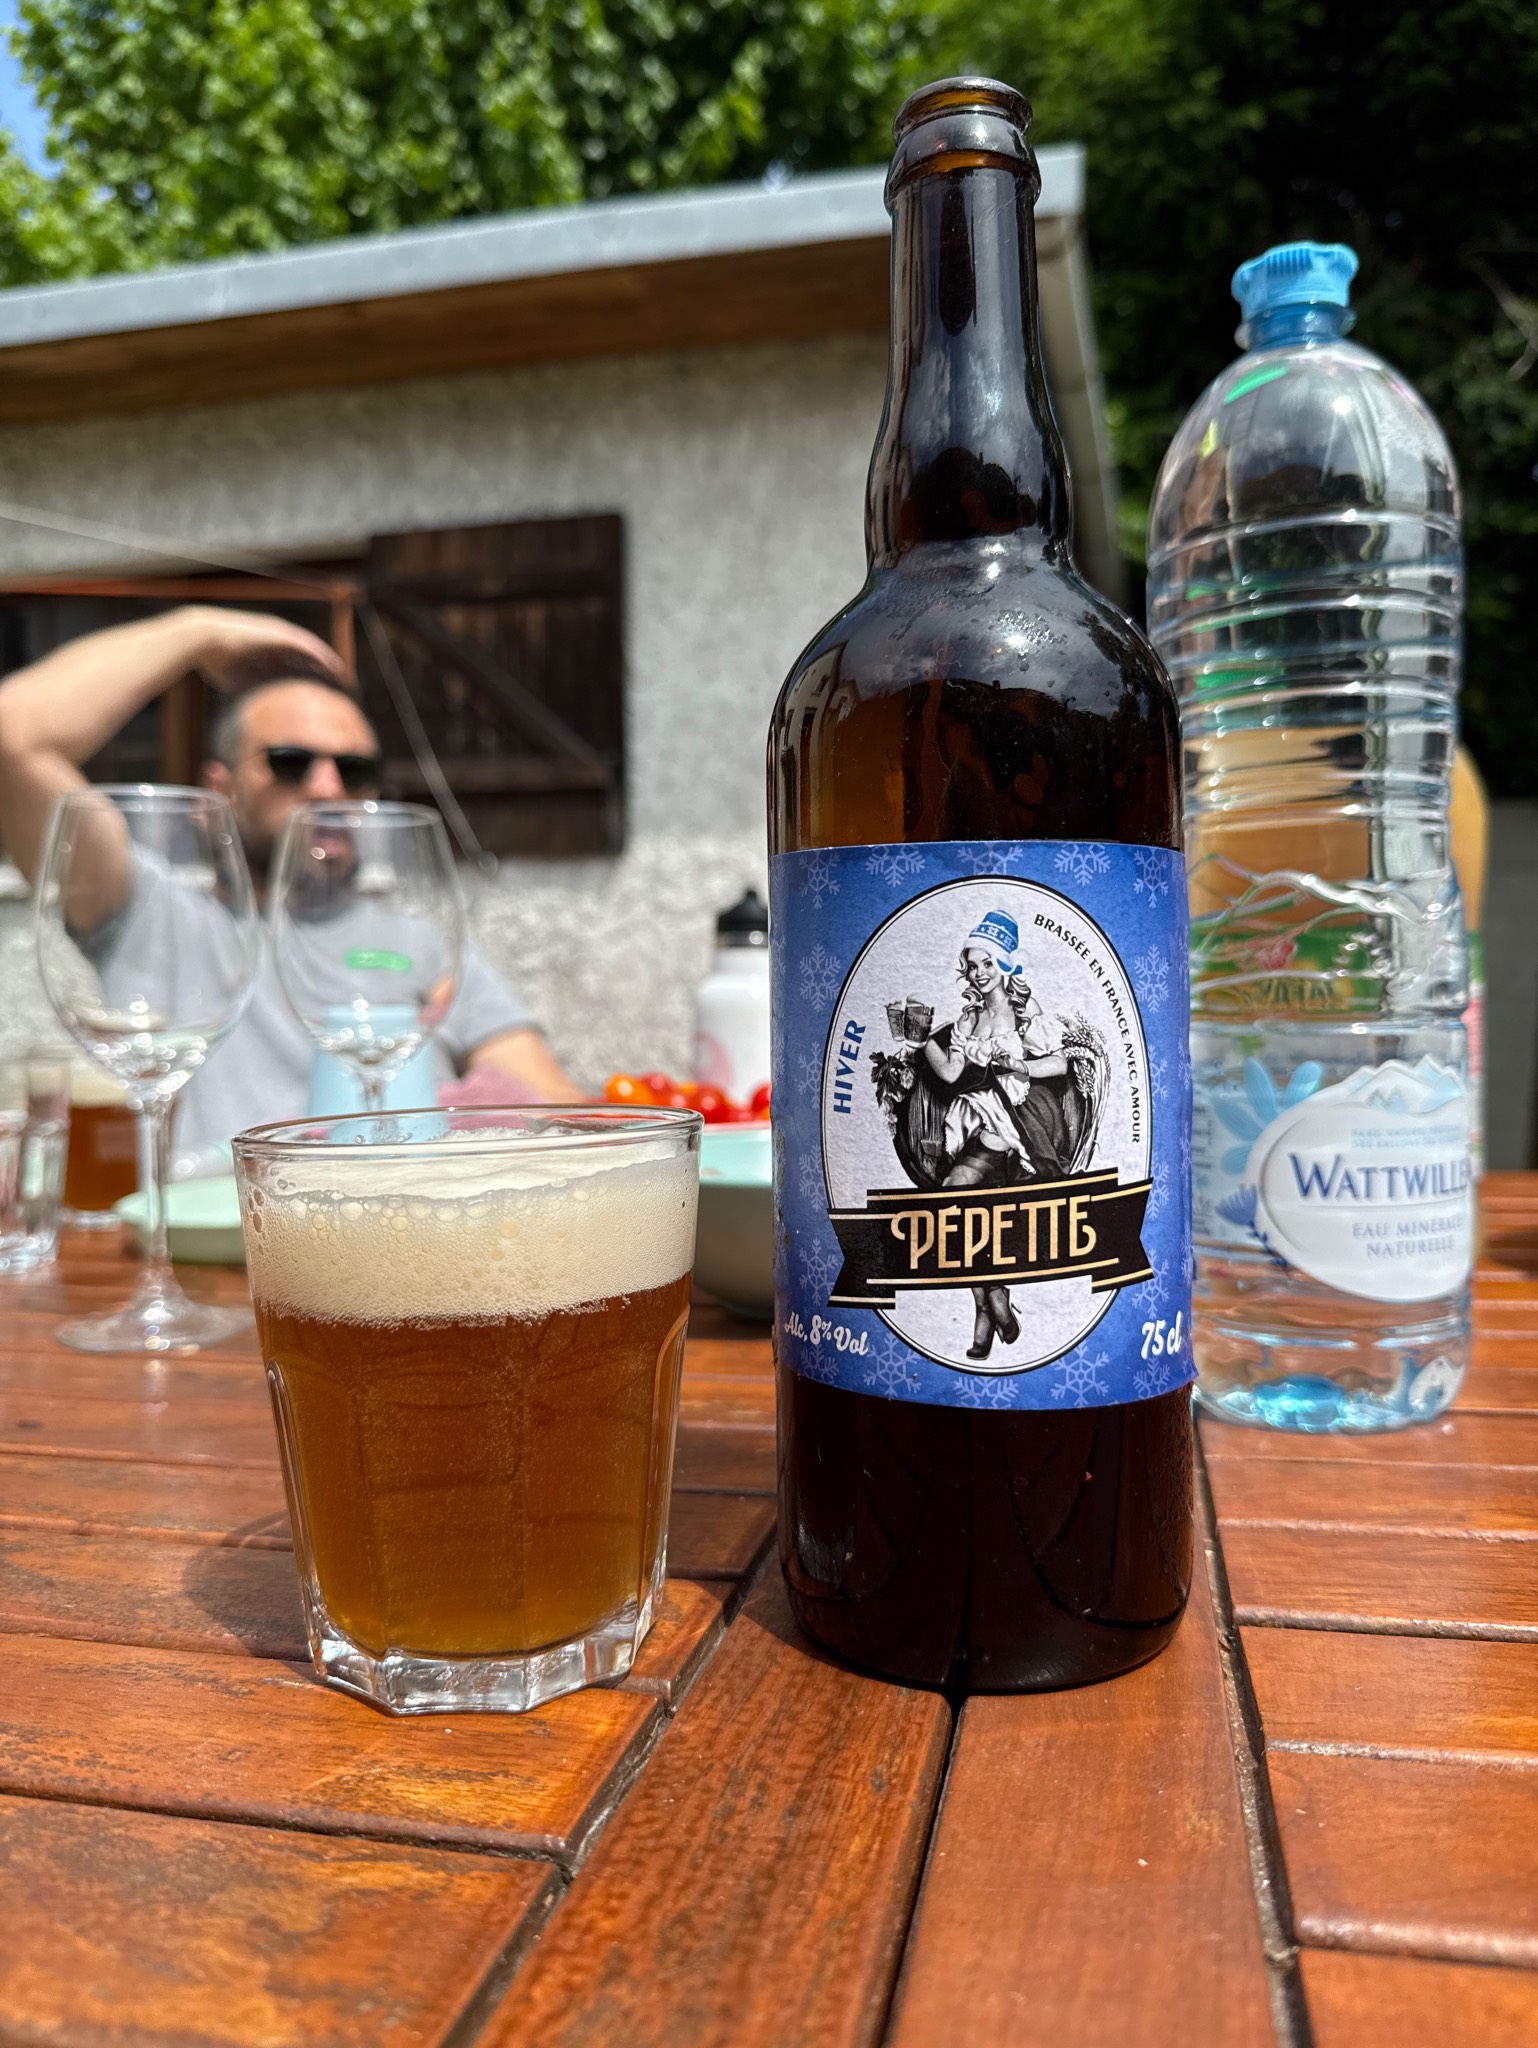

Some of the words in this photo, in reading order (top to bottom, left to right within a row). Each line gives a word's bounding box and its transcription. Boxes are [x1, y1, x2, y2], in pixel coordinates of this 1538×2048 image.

[1033, 913, 1091, 961] BRASSÉE
[1088, 958, 1105, 979] EN
[1101, 979, 1130, 1039] FRANCE
[833, 1019, 867, 1114] HIVER
[1123, 1041, 1138, 1081] AVEC
[1130, 1085, 1141, 1144] AMOUR
[890, 1194, 1097, 1269] PÉPETTE
[1352, 1222, 1389, 1238] EAU
[1366, 1234, 1456, 1257] NATURELLE
[809, 1314, 832, 1345] 8%
[833, 1325, 869, 1356] Vol
[1140, 1319, 1166, 1360] 75
[1166, 1310, 1182, 1356] cl
